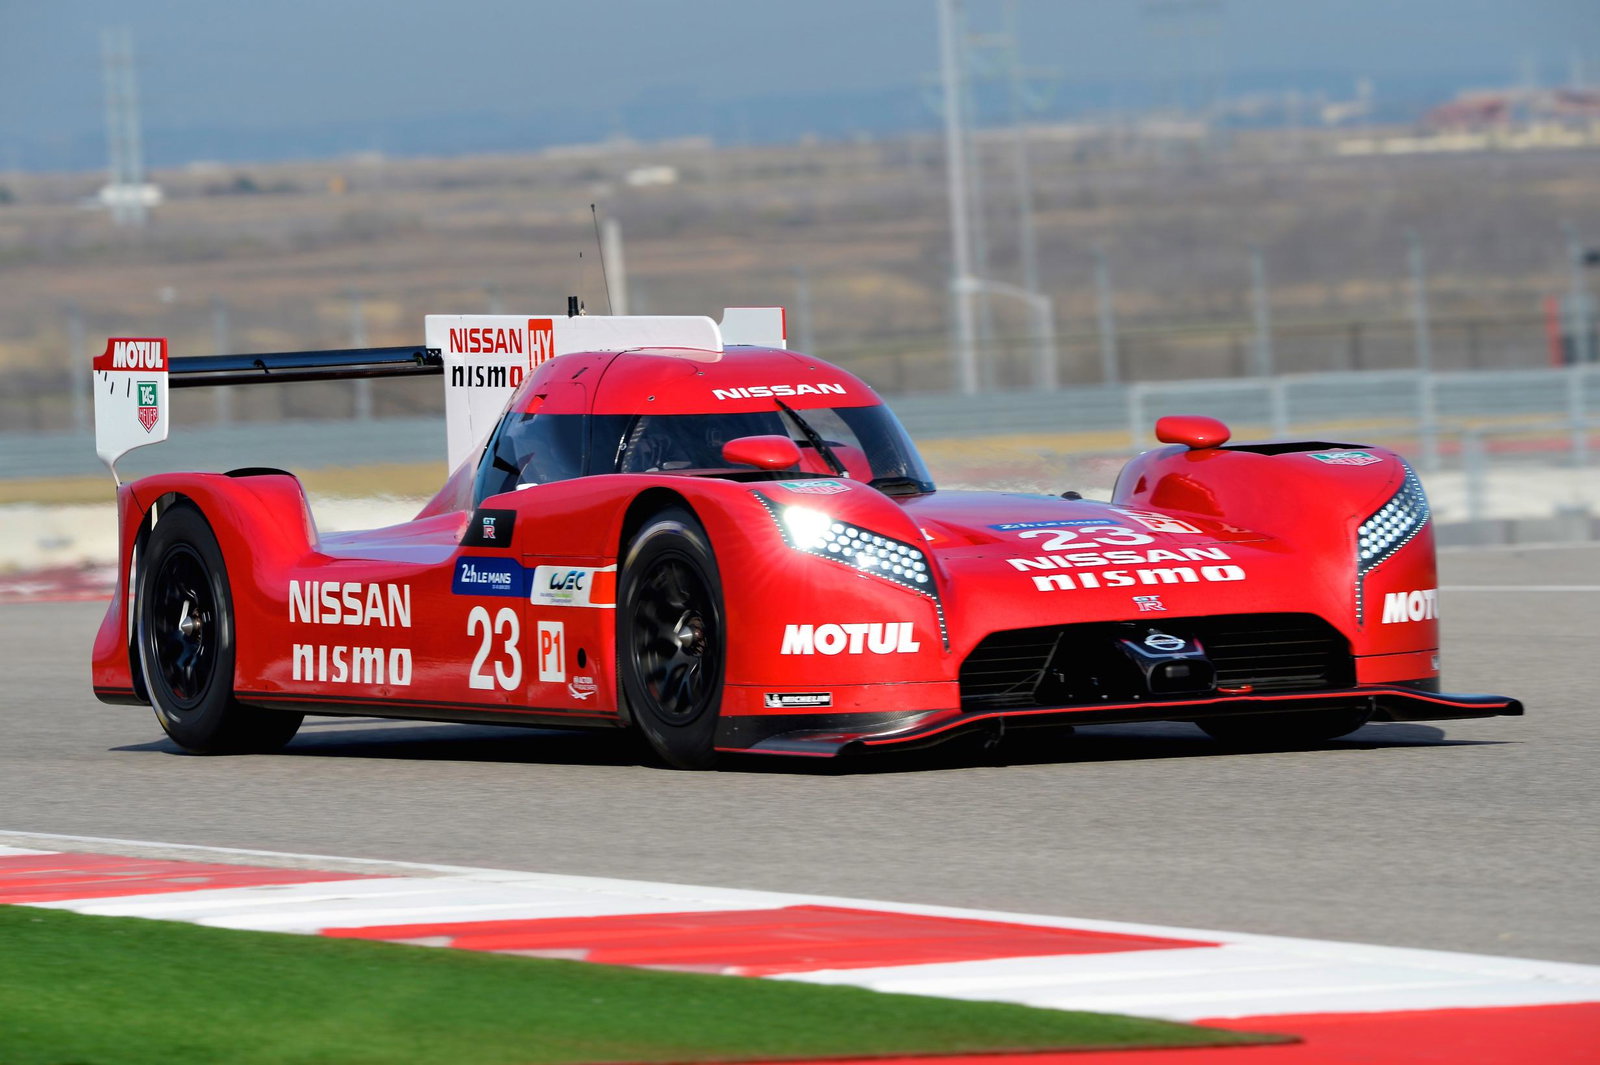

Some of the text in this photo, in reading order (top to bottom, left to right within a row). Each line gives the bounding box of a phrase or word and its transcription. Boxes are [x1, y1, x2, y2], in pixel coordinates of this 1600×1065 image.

[449, 328, 523, 353] NISSAN
[530, 329, 552, 371] HY
[113, 341, 163, 368] MOTUL
[452, 366, 523, 387] nismo
[140, 386, 155, 405] TAG
[712, 383, 847, 400] NISSAN
[139, 408, 158, 429] HEUER
[483, 525, 496, 539] R
[1018, 526, 1155, 551] 23
[1006, 547, 1232, 572] NISSAN
[477, 571, 488, 583] LE
[487, 572, 511, 584] MANS
[549, 570, 586, 591] WEC
[1032, 565, 1247, 592] nismo
[289, 580, 412, 628] NISSAN
[467, 605, 523, 691] 23
[541, 630, 562, 673] P1
[780, 622, 921, 656] MOTUL
[293, 643, 413, 686] nismo
